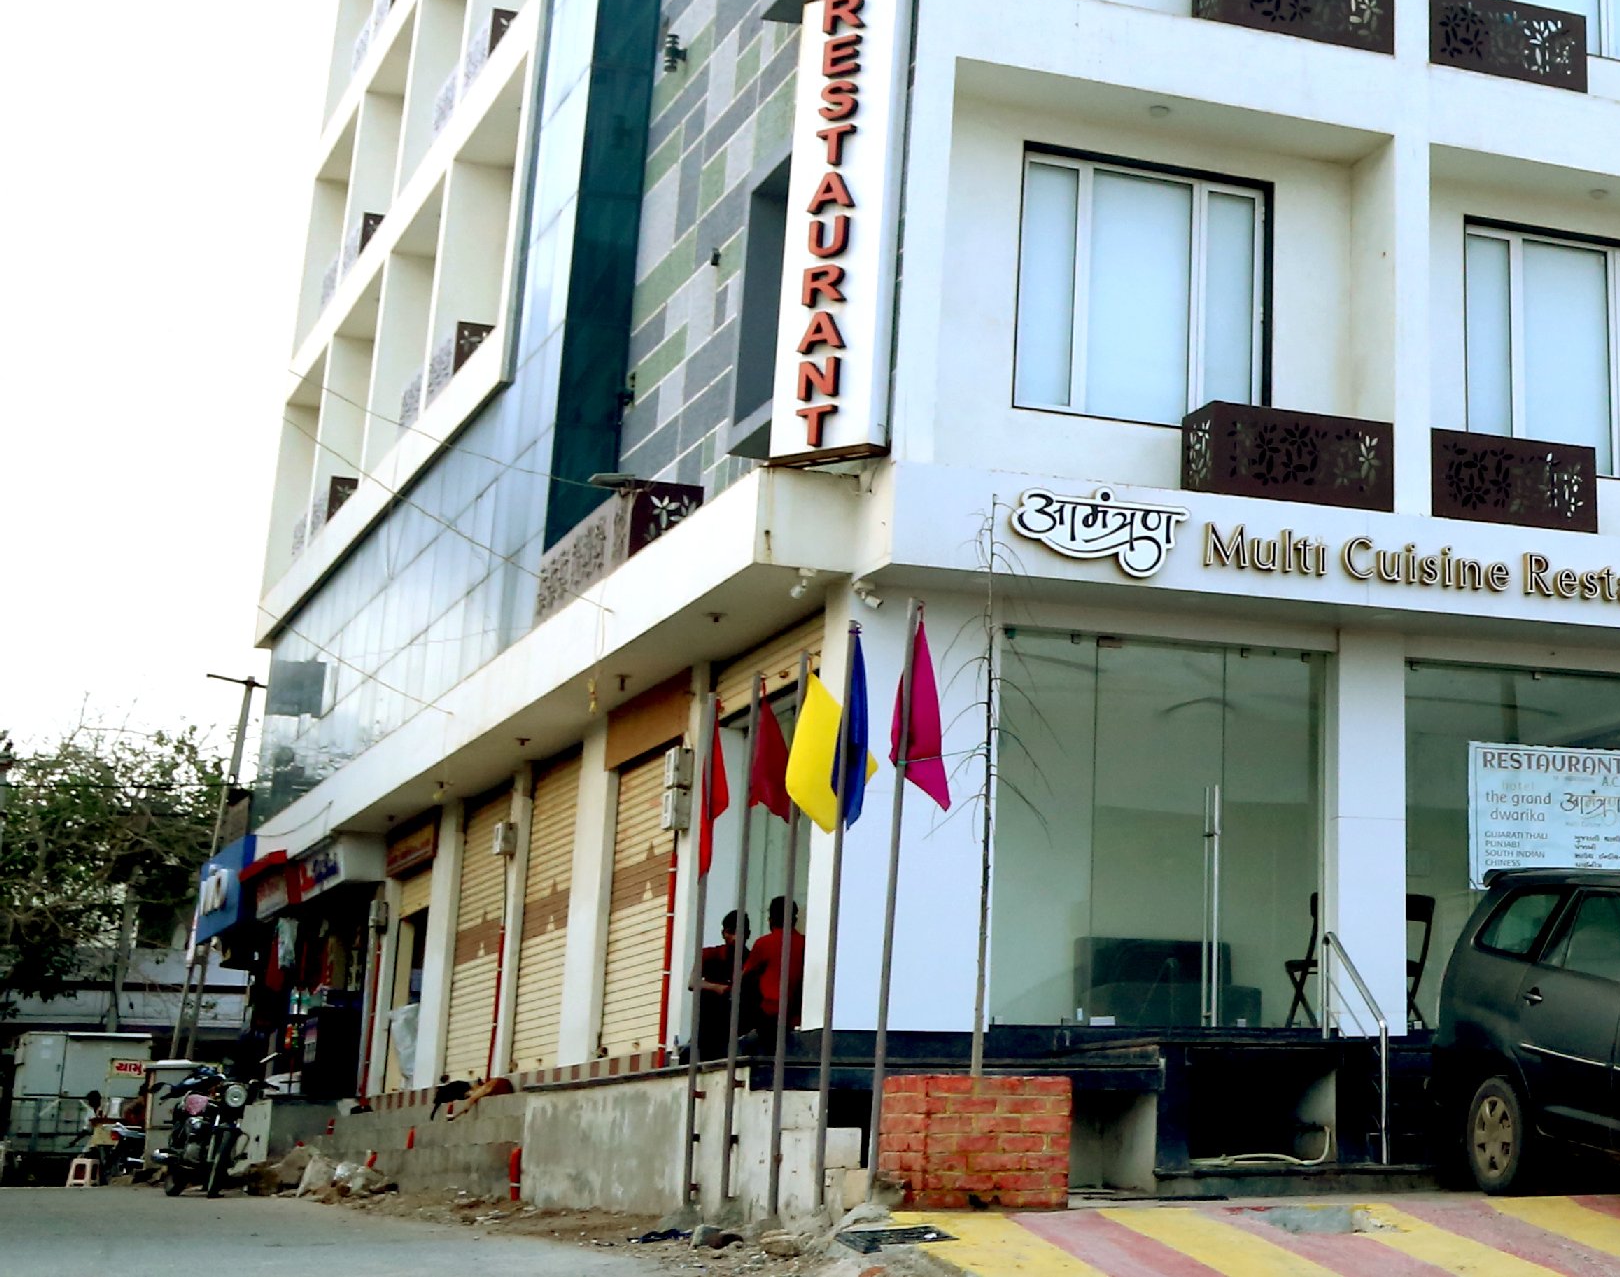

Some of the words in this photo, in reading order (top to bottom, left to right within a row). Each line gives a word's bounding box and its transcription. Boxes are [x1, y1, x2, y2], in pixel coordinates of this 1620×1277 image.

[1014, 489, 1189, 575] आमंत्रण
[1203, 521, 1328, 577] Multi
[1343, 535, 1511, 593] Cuisine
[1486, 790, 1507, 803] the
[1511, 792, 1552, 807] grand
[1490, 810, 1545, 822] dwarika
[1485, 831, 1523, 839] GUJARATI
[1485, 840, 1520, 848] PUNJABI
